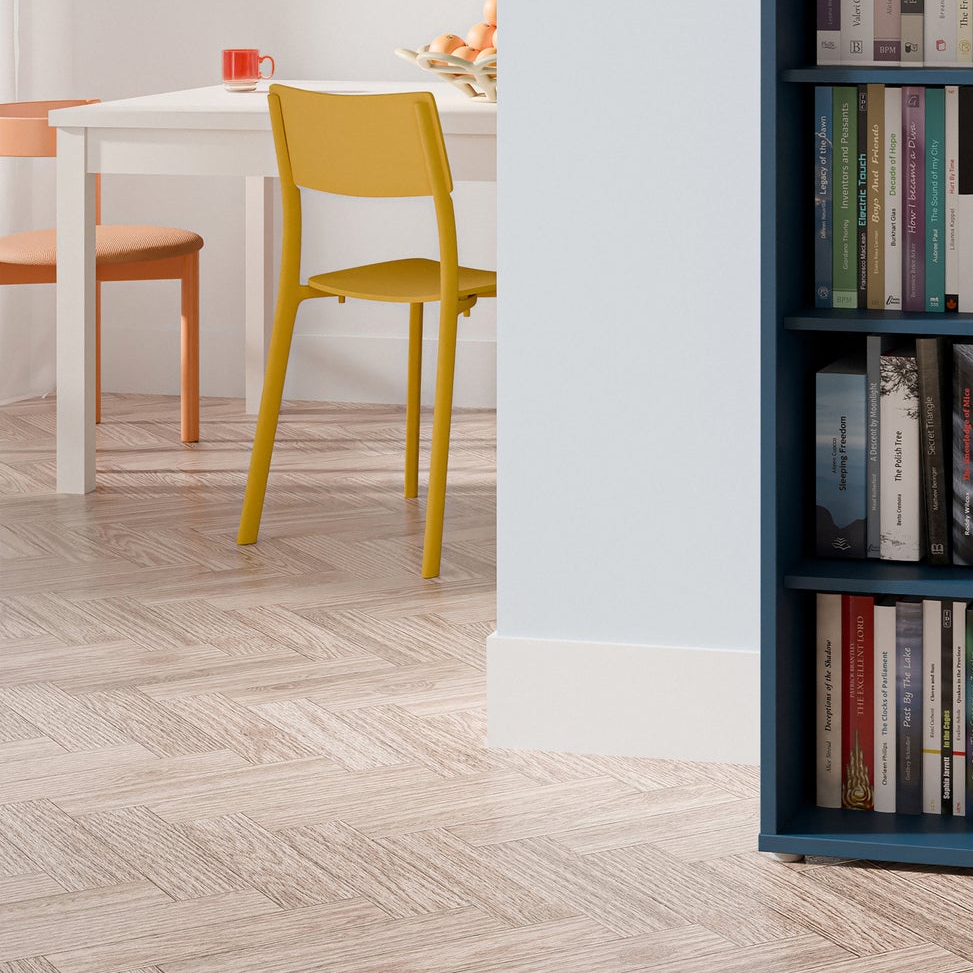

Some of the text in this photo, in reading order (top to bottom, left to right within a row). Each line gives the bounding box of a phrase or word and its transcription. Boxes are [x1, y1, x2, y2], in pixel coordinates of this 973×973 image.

[853, 5, 861, 26] Valeri
[960, 12, 968, 28] The
[879, 46, 896, 54] BPM
[889, 134, 897, 154] Hope
[931, 140, 939, 155] City
[819, 156, 826, 164] of
[841, 102, 849, 209] Inventors and Peasants
[889, 156, 896, 164] of
[933, 157, 939, 169] my
[819, 167, 828, 194] Legacy
[931, 171, 938, 179] of
[859, 154, 867, 226] Electric Touch
[872, 197, 881, 223] Boys
[870, 382, 878, 418] Moonlight
[870, 419, 878, 427] by
[925, 396, 936, 455] Secret Triangle
[894, 431, 902, 481] The Polish Tree
[839, 456, 848, 490] Sleeping
[903, 647, 911, 669] Lake
[824, 640, 833, 731] Deceptions of the Shadow
[903, 672, 911, 688] The
[903, 692, 913, 704] By
[903, 707, 911, 728] Past
